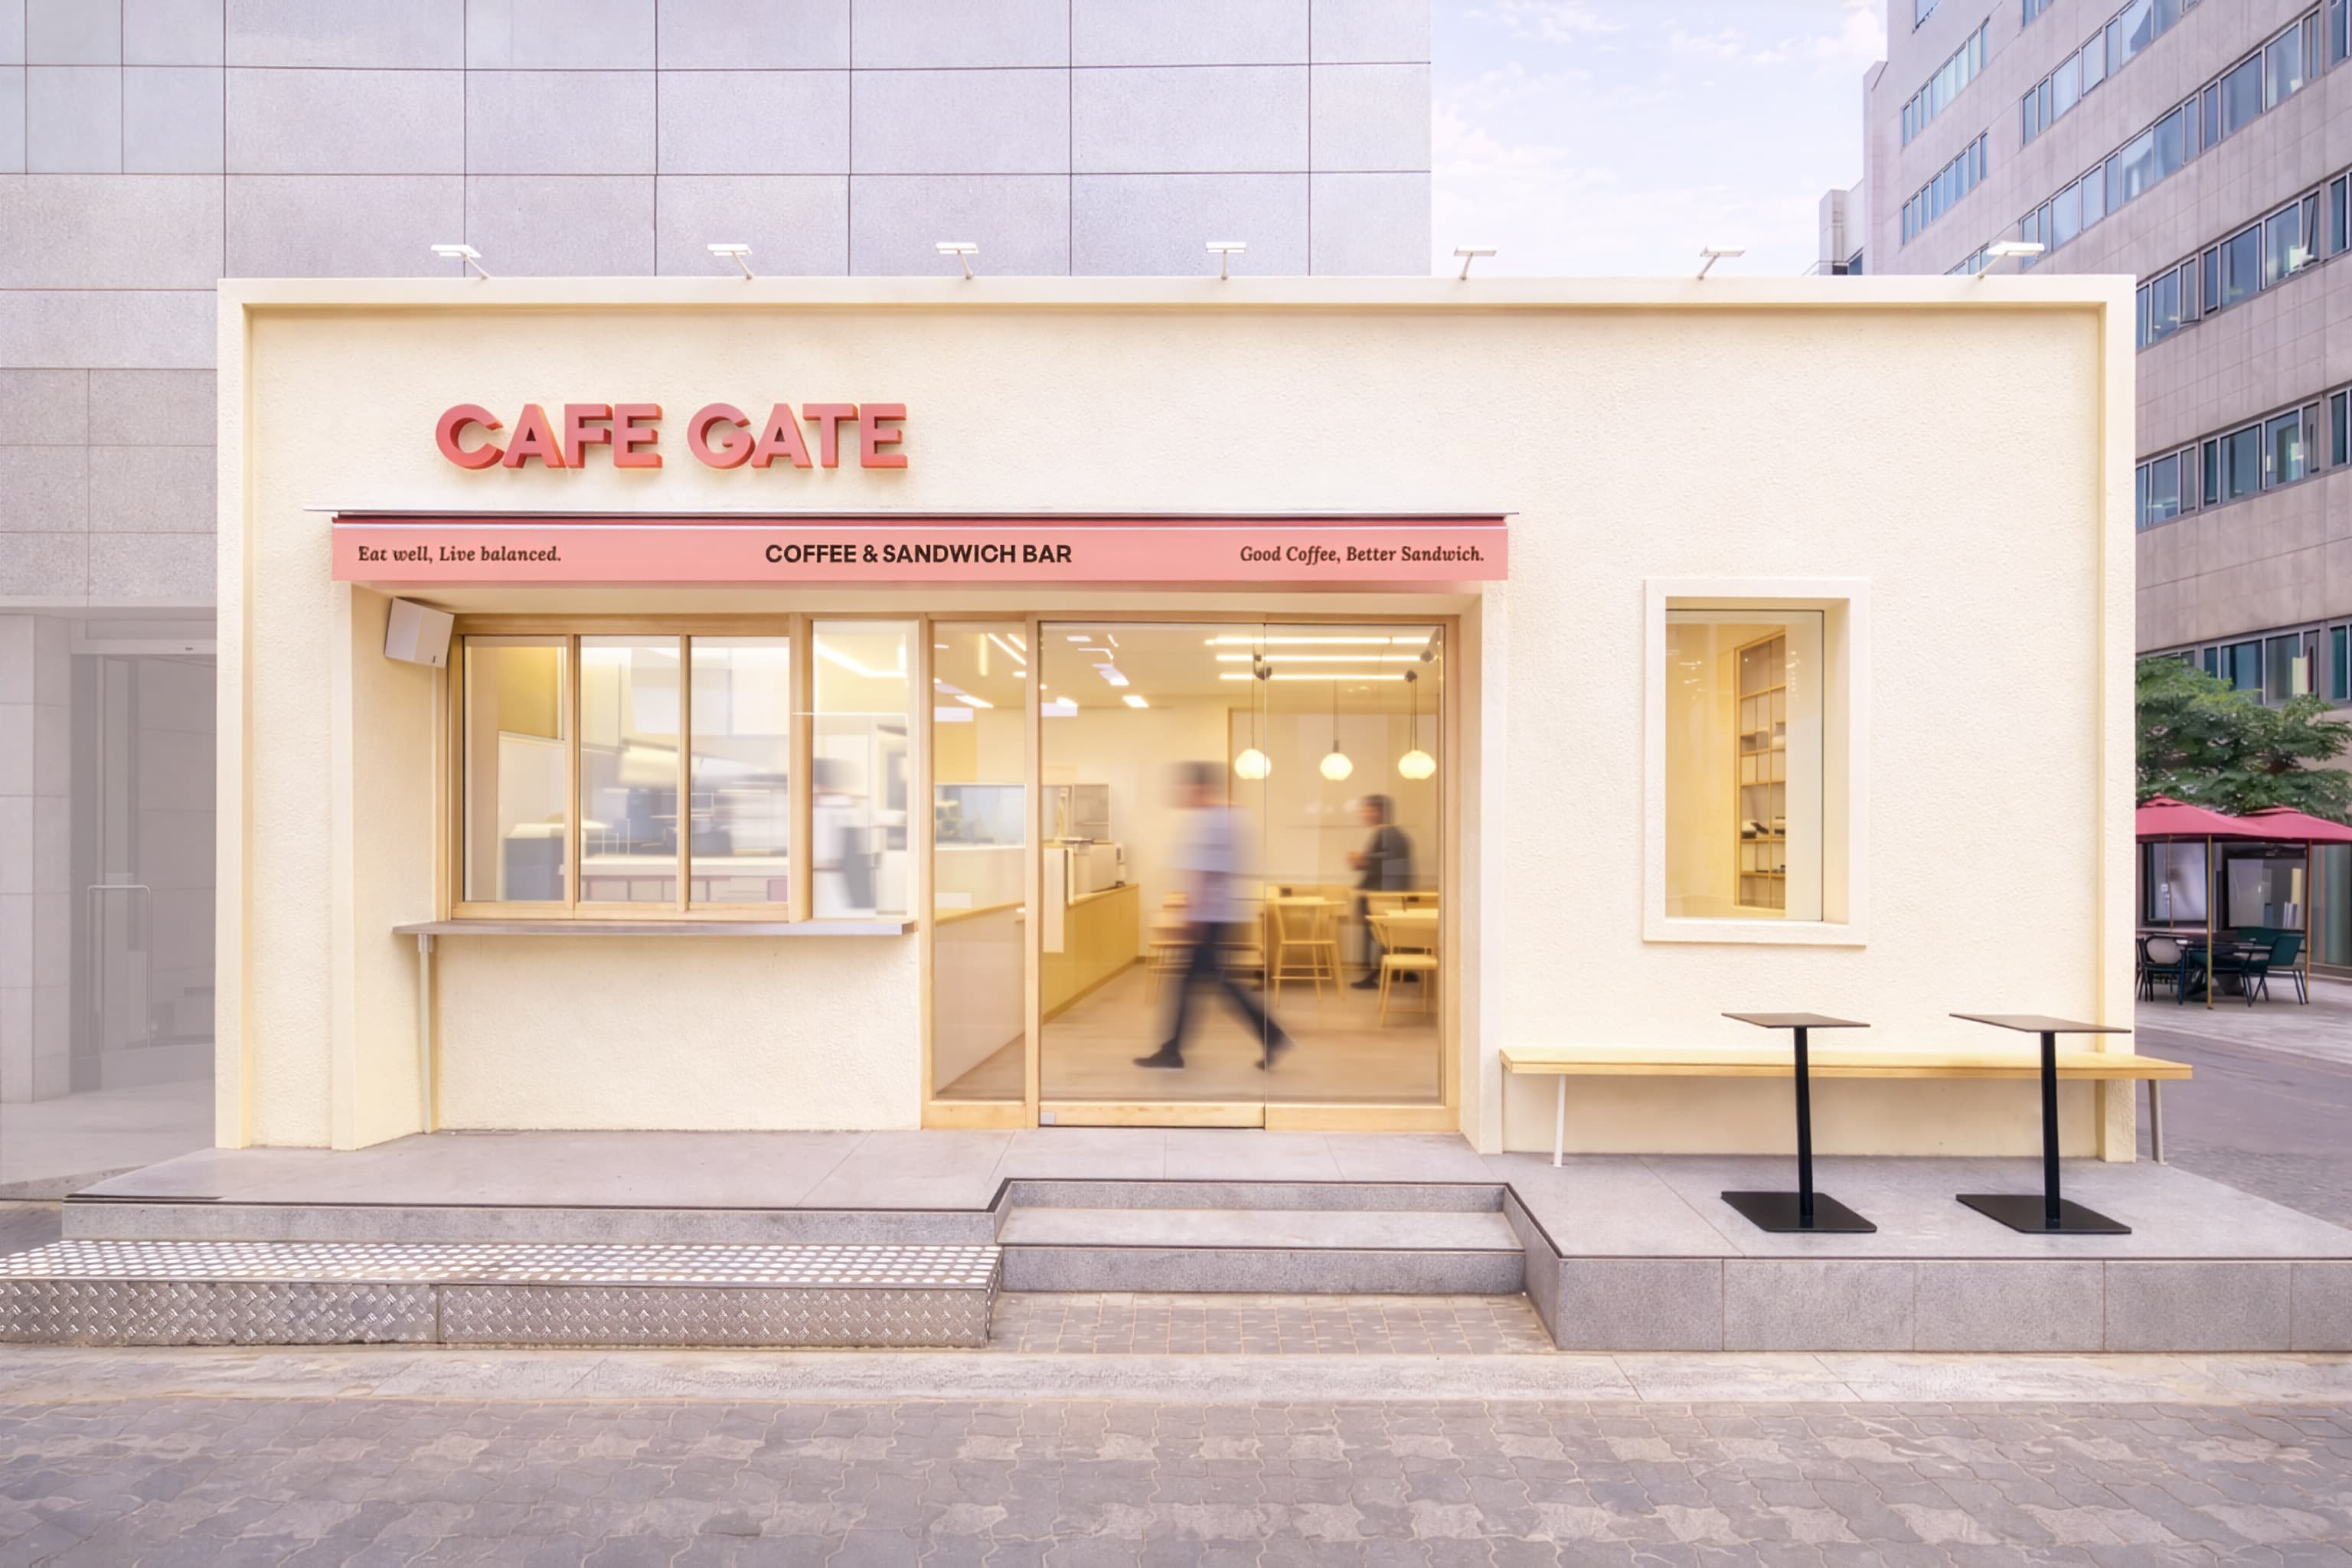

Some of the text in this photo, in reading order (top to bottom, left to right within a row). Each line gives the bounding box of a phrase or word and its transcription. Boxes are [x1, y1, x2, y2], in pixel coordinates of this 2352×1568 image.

[435, 403, 908, 470] CAFE GATE
[358, 545, 562, 564] Eat well, Live balanced.
[765, 544, 1072, 564] COFFEE & SANDWICH BAR
[1240, 544, 1485, 567] Good Coffee, Better Sandwich.
